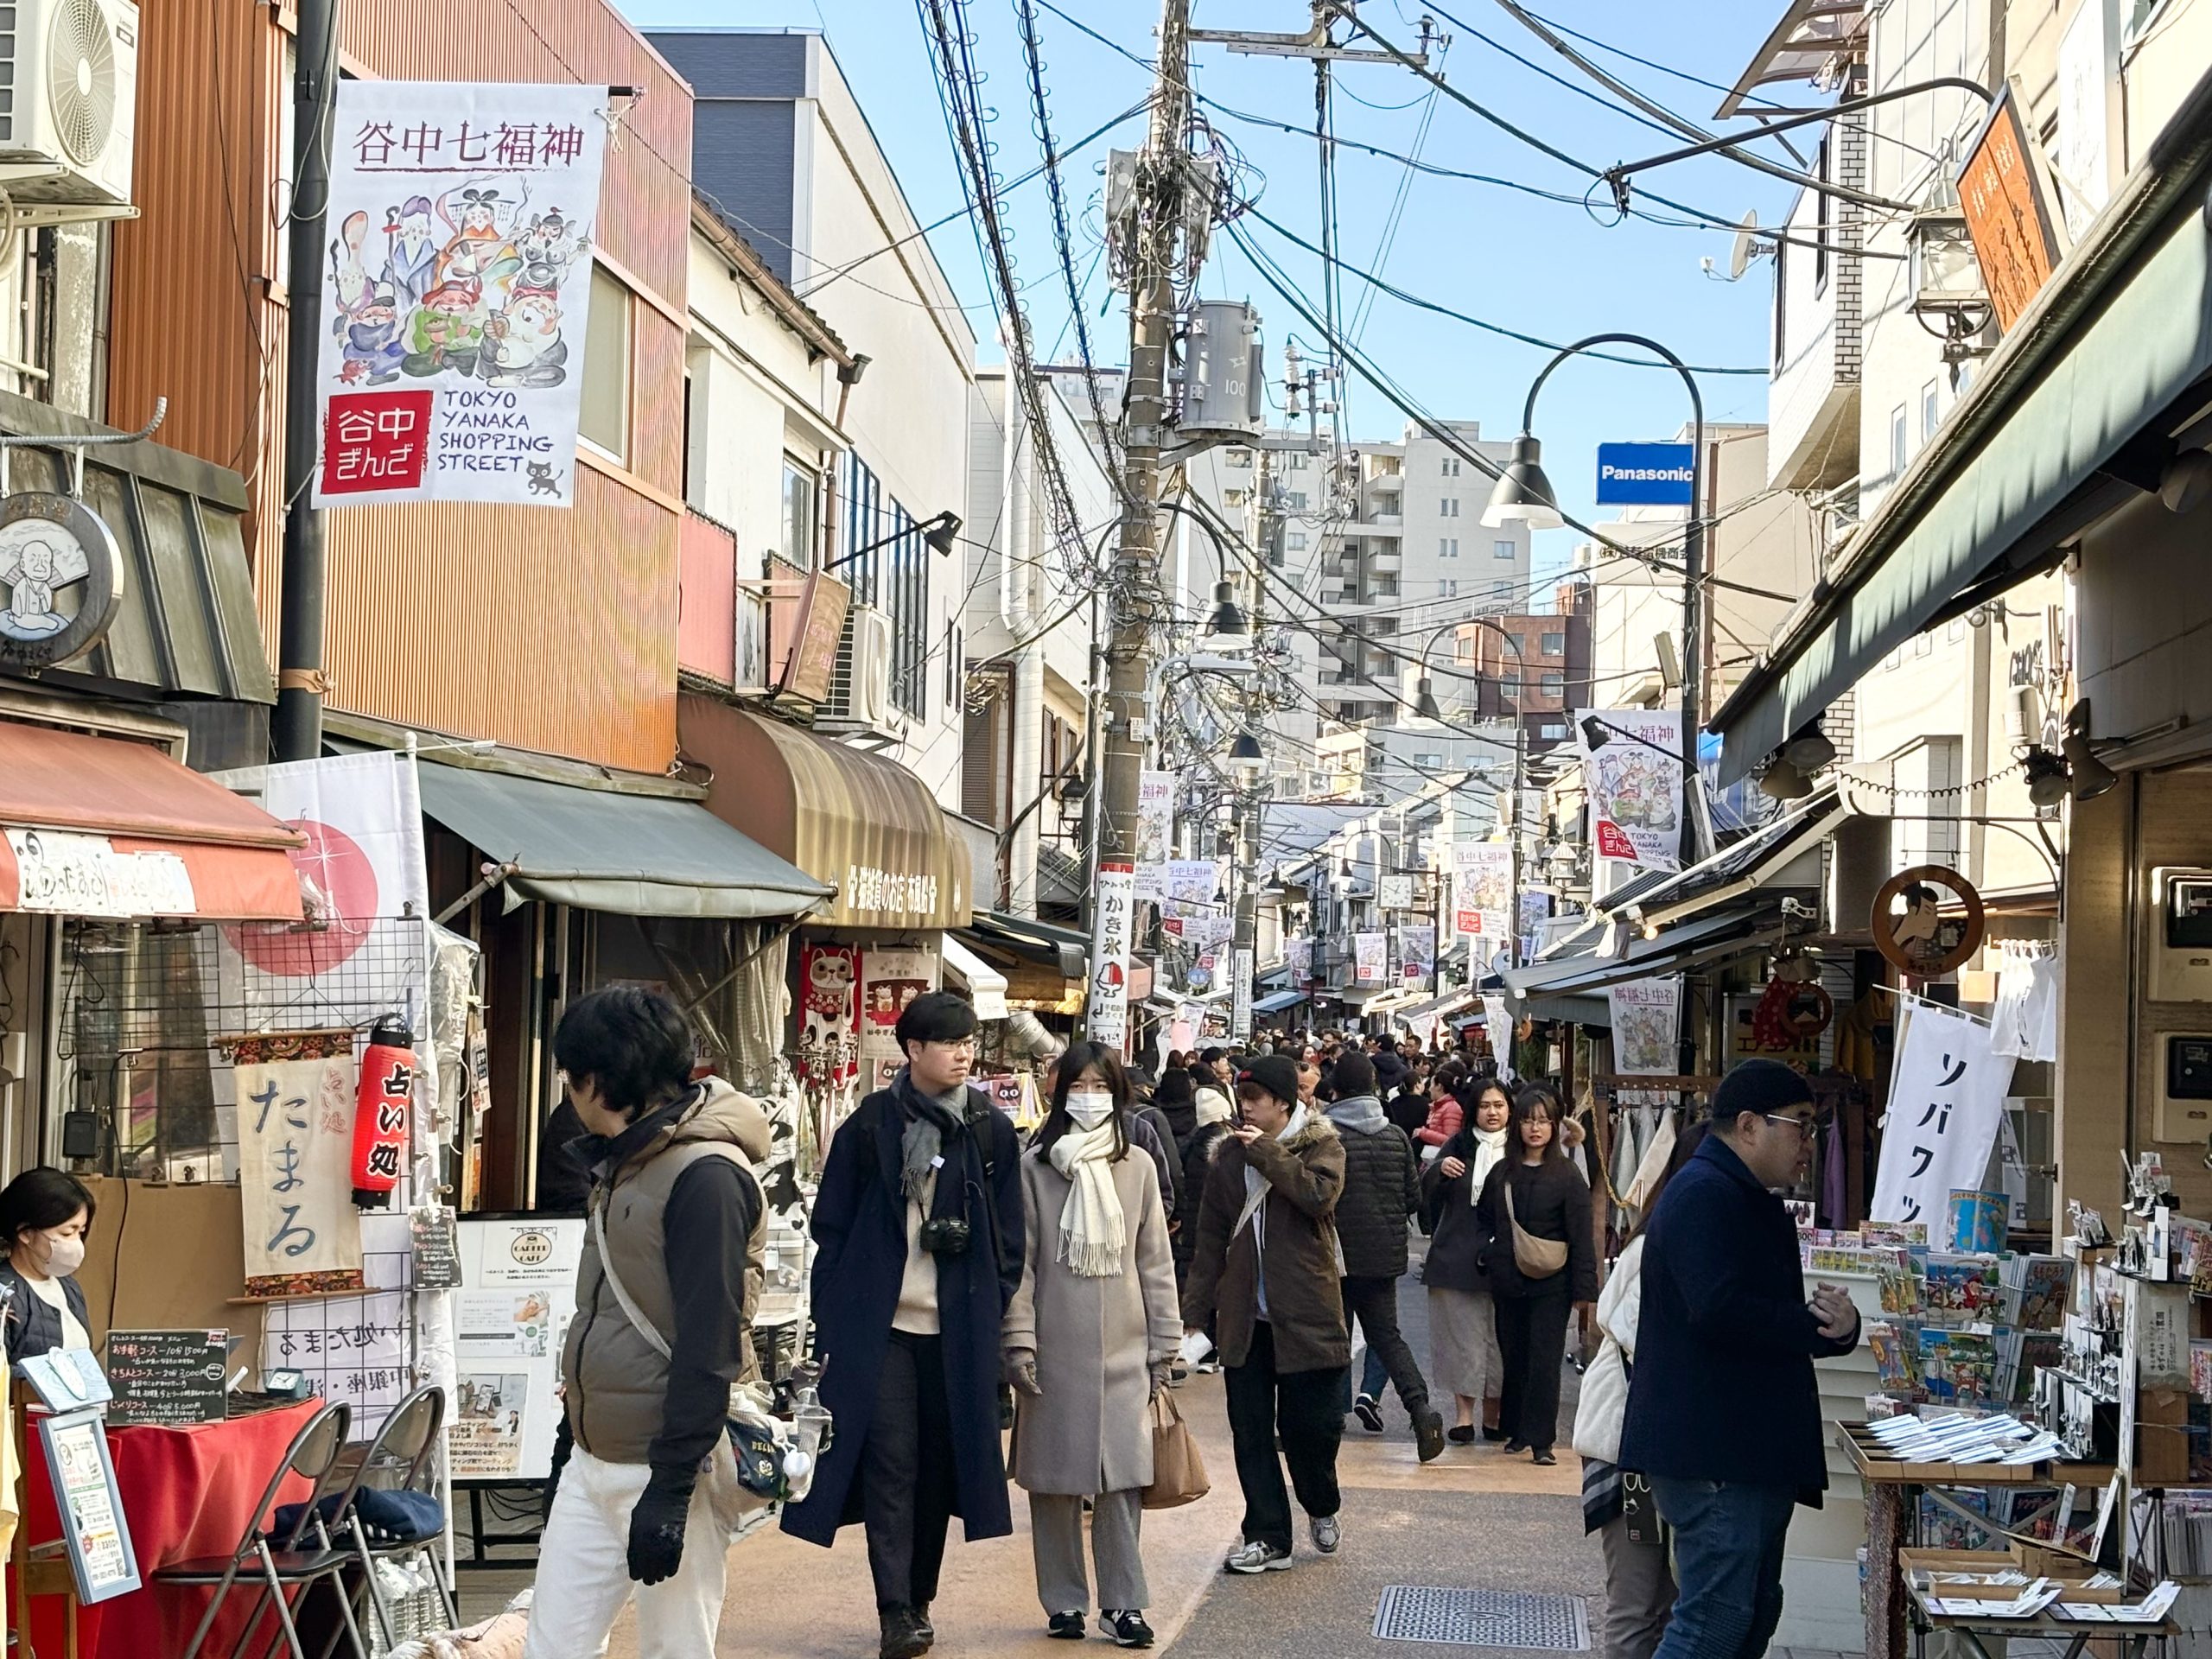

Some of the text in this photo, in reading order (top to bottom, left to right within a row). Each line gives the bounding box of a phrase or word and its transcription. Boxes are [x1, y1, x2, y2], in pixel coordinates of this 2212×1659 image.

[352, 120, 585, 167] 谷中七福神
[444, 391, 517, 409] TOKYO
[1224, 380, 1246, 397] 100
[338, 408, 416, 444] 谷中
[442, 411, 530, 430] YANAKA
[439, 433, 554, 453] SHOPPING
[336, 442, 414, 481] ぎんざ
[438, 454, 524, 473] STREET
[1601, 465, 1693, 481] Panasonic
[858, 866, 905, 913] 猫雑貨のお店
[1103, 895, 1123, 956] かき氷
[368, 1062, 411, 1177] 占い処
[249, 1080, 316, 1257] たまる
